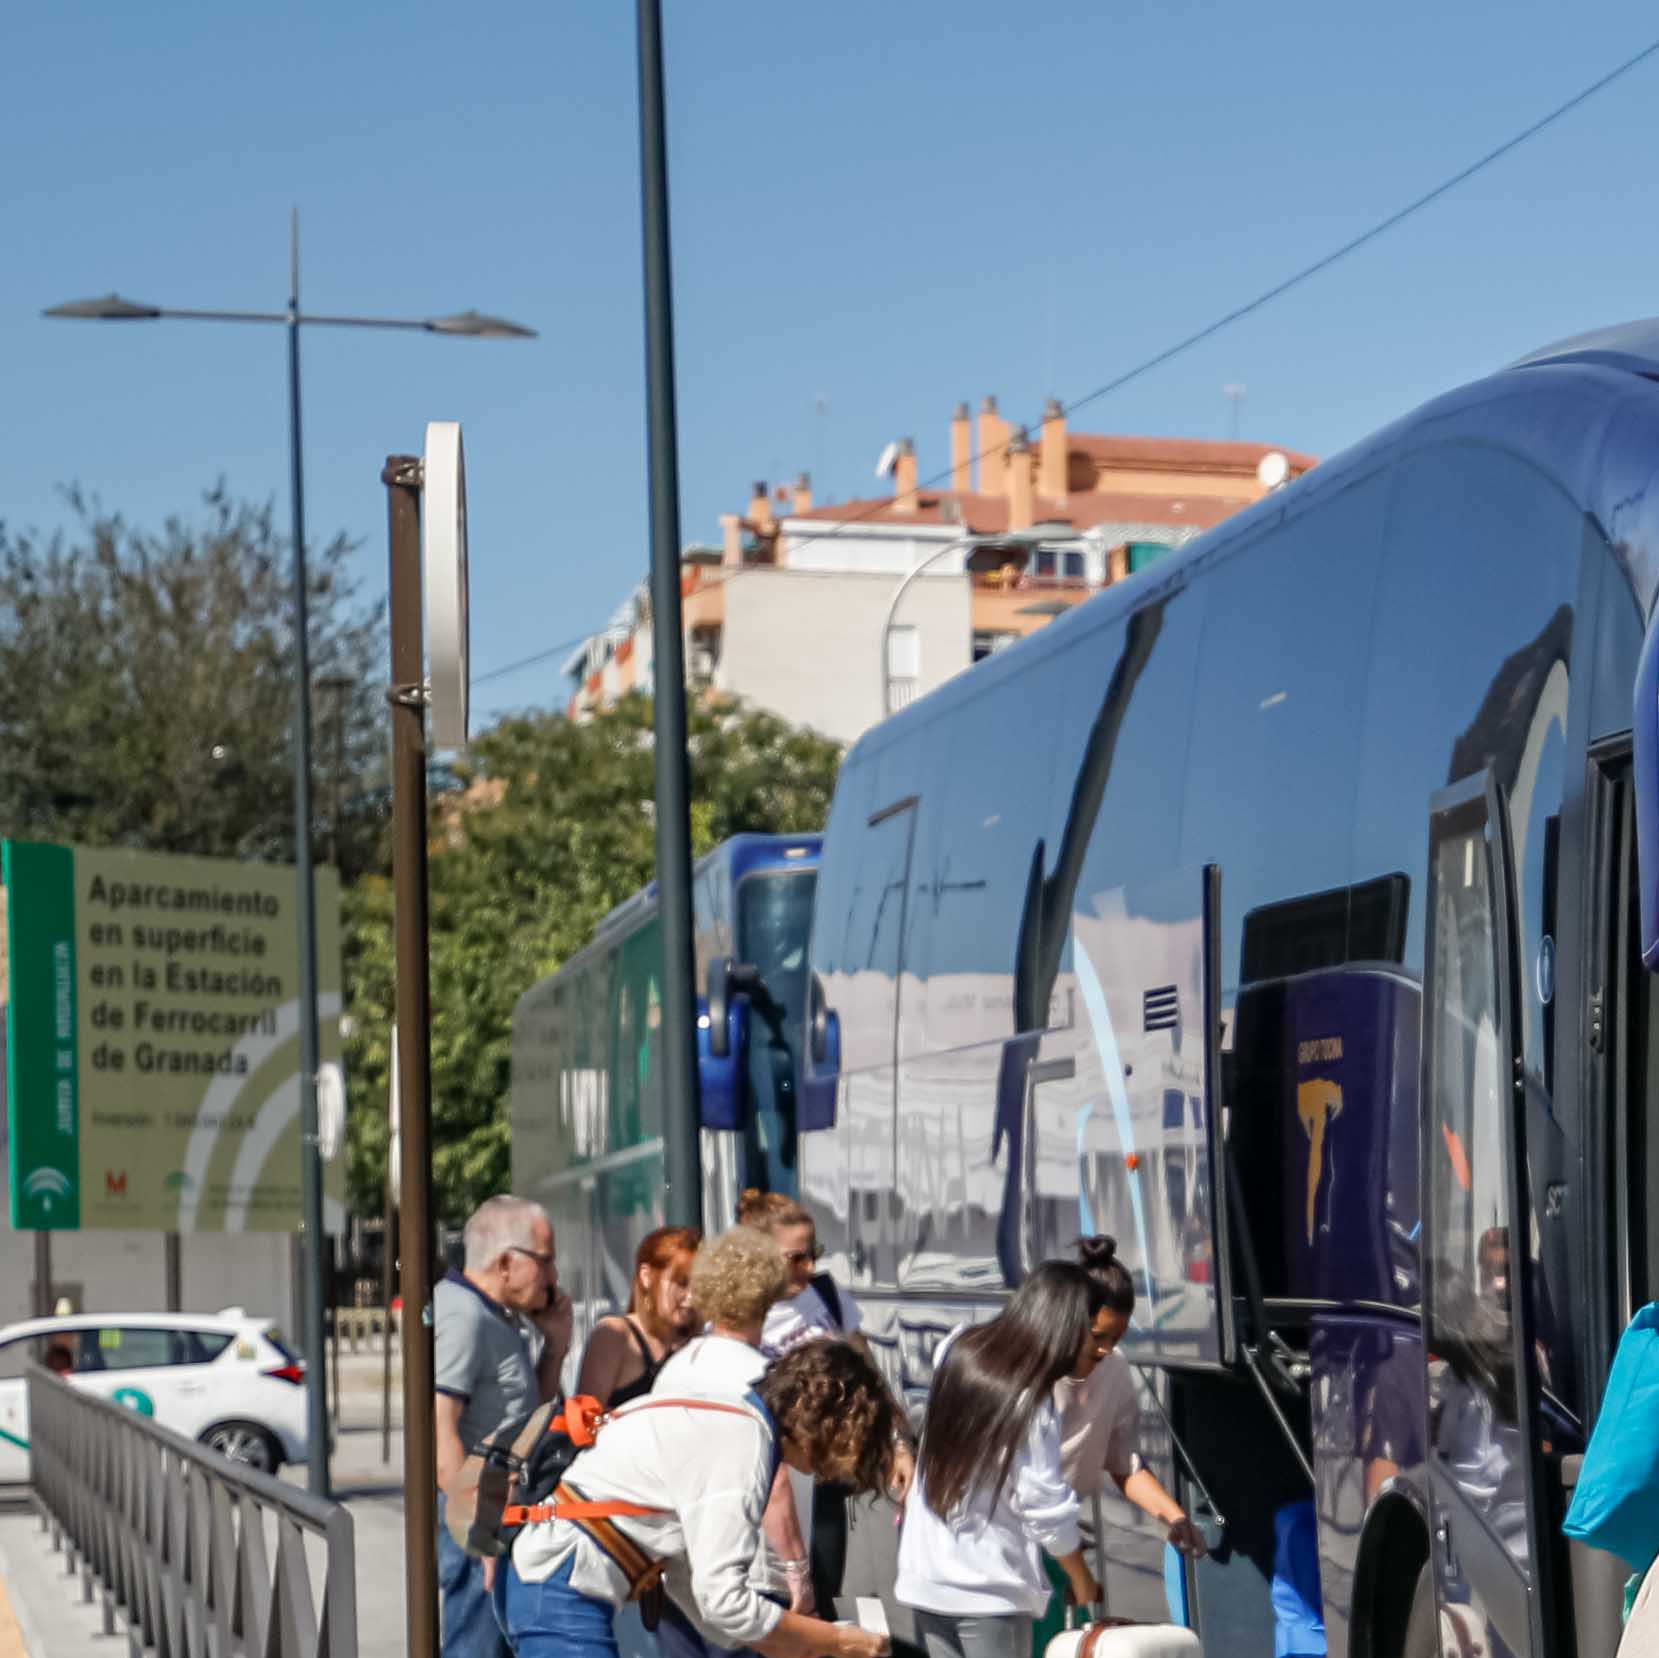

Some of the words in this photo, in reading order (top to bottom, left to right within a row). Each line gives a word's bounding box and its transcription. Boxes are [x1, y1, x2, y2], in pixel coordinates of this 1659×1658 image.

[89, 873, 279, 919] Aparcamiento
[89, 922, 122, 945] en
[132, 923, 266, 958] superficie
[90, 965, 123, 987] en
[133, 961, 156, 990] la
[165, 961, 281, 996] Estación
[91, 1001, 124, 1029] de
[134, 1001, 277, 1036] Ferrocarril
[92, 1043, 124, 1071] de
[135, 1043, 248, 1074] Granada
